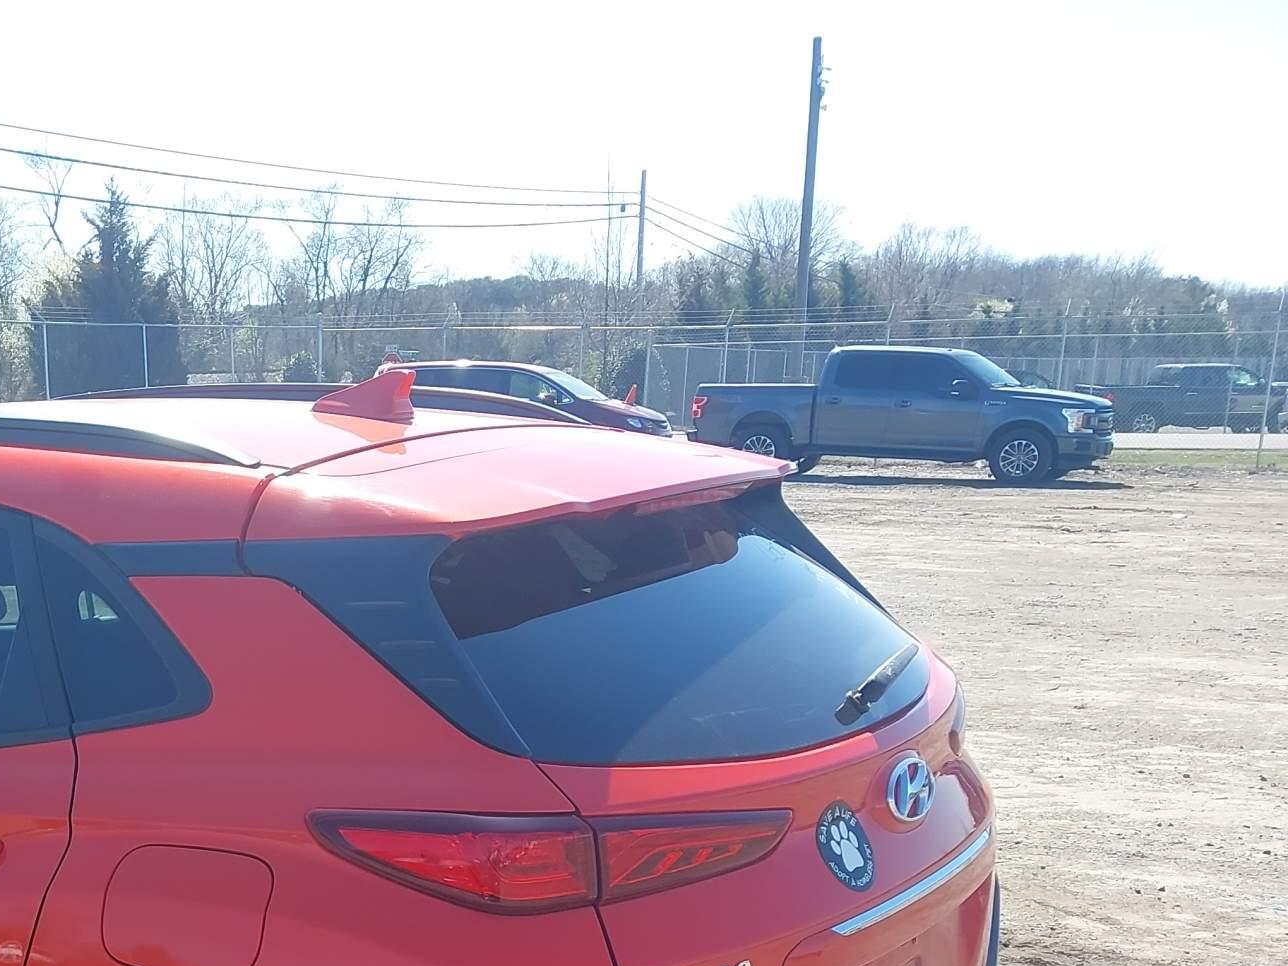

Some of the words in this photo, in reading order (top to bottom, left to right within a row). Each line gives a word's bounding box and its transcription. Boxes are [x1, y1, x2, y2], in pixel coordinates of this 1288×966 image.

[819, 809, 833, 844] SAVE
[833, 805, 841, 819] A
[841, 807, 857, 827] LIFE
[828, 861, 850, 883] ADOPT
